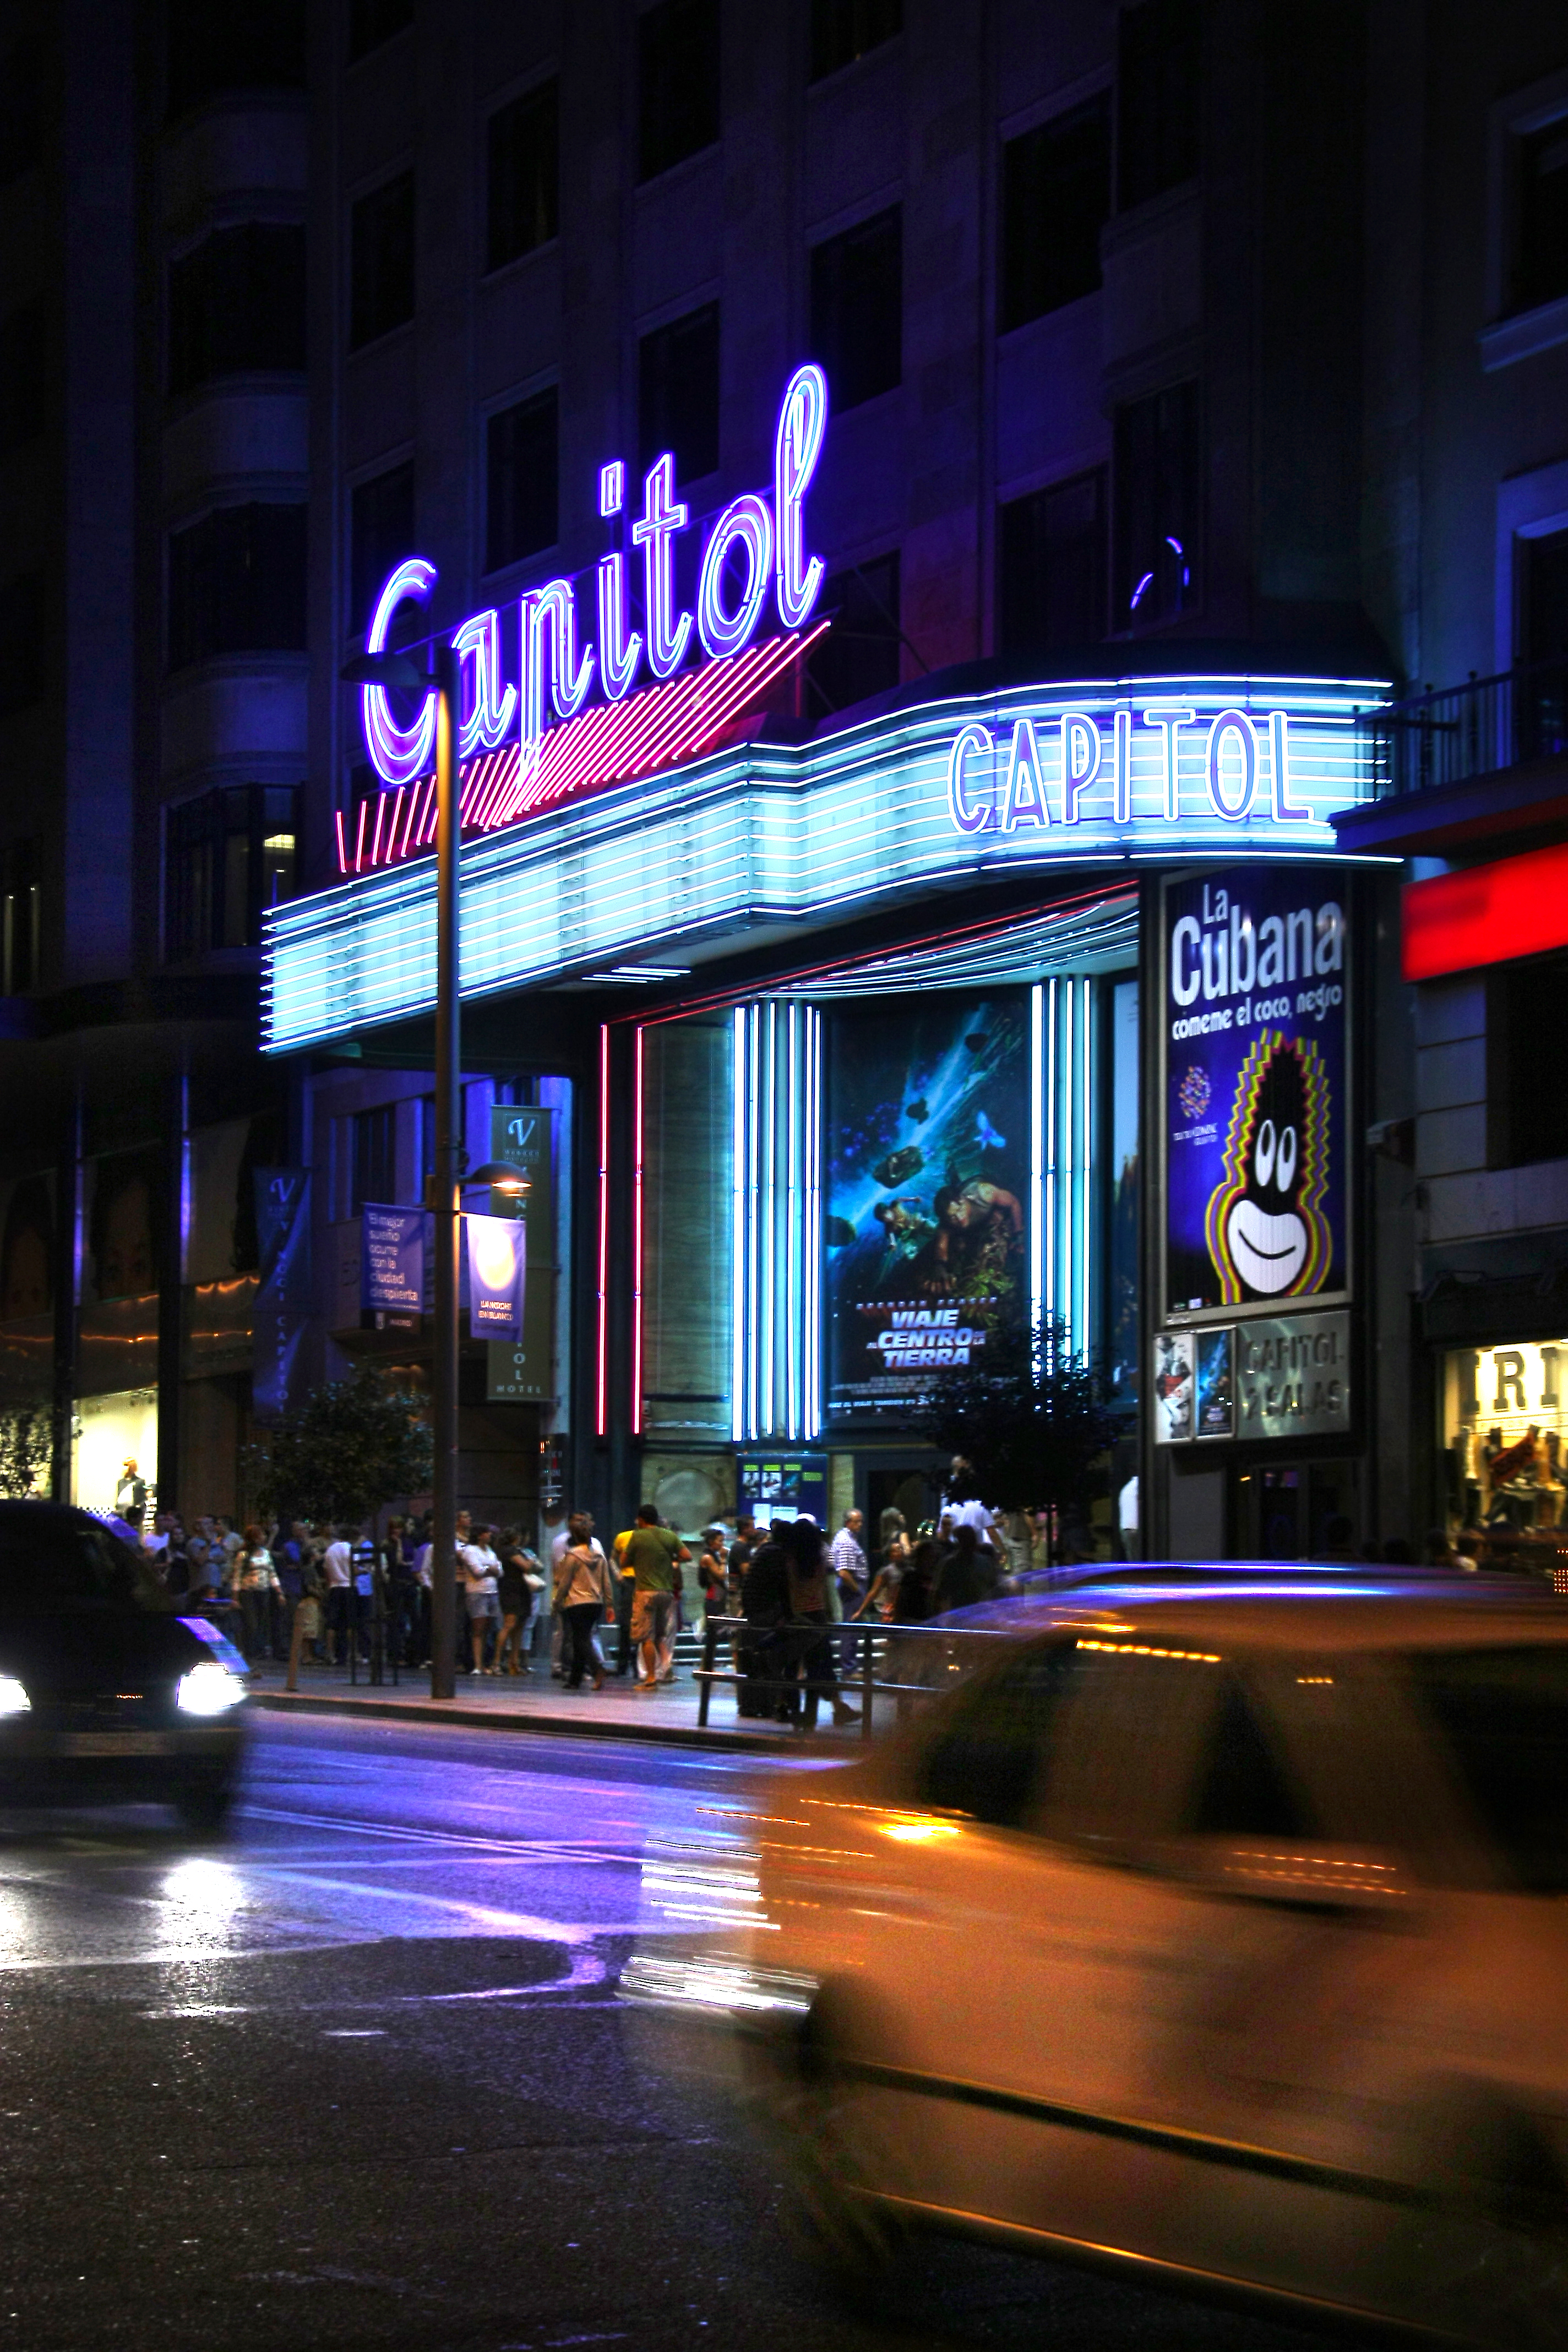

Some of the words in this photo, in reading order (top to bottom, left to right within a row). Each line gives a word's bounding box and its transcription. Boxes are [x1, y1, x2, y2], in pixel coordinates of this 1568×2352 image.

[362, 363, 825, 794] Capitol
[948, 707, 1315, 835] CAPITOL
[1203, 884, 1228, 924] La
[1172, 901, 1342, 1006] Cubana
[1172, 1009, 1233, 1040] comeme
[1235, 997, 1252, 1026] el
[1296, 983, 1342, 1021] negro
[878, 1327, 973, 1349] CENTRO
[891, 1308, 960, 1329] VIAJE
[883, 1347, 971, 1368] TIERRA
